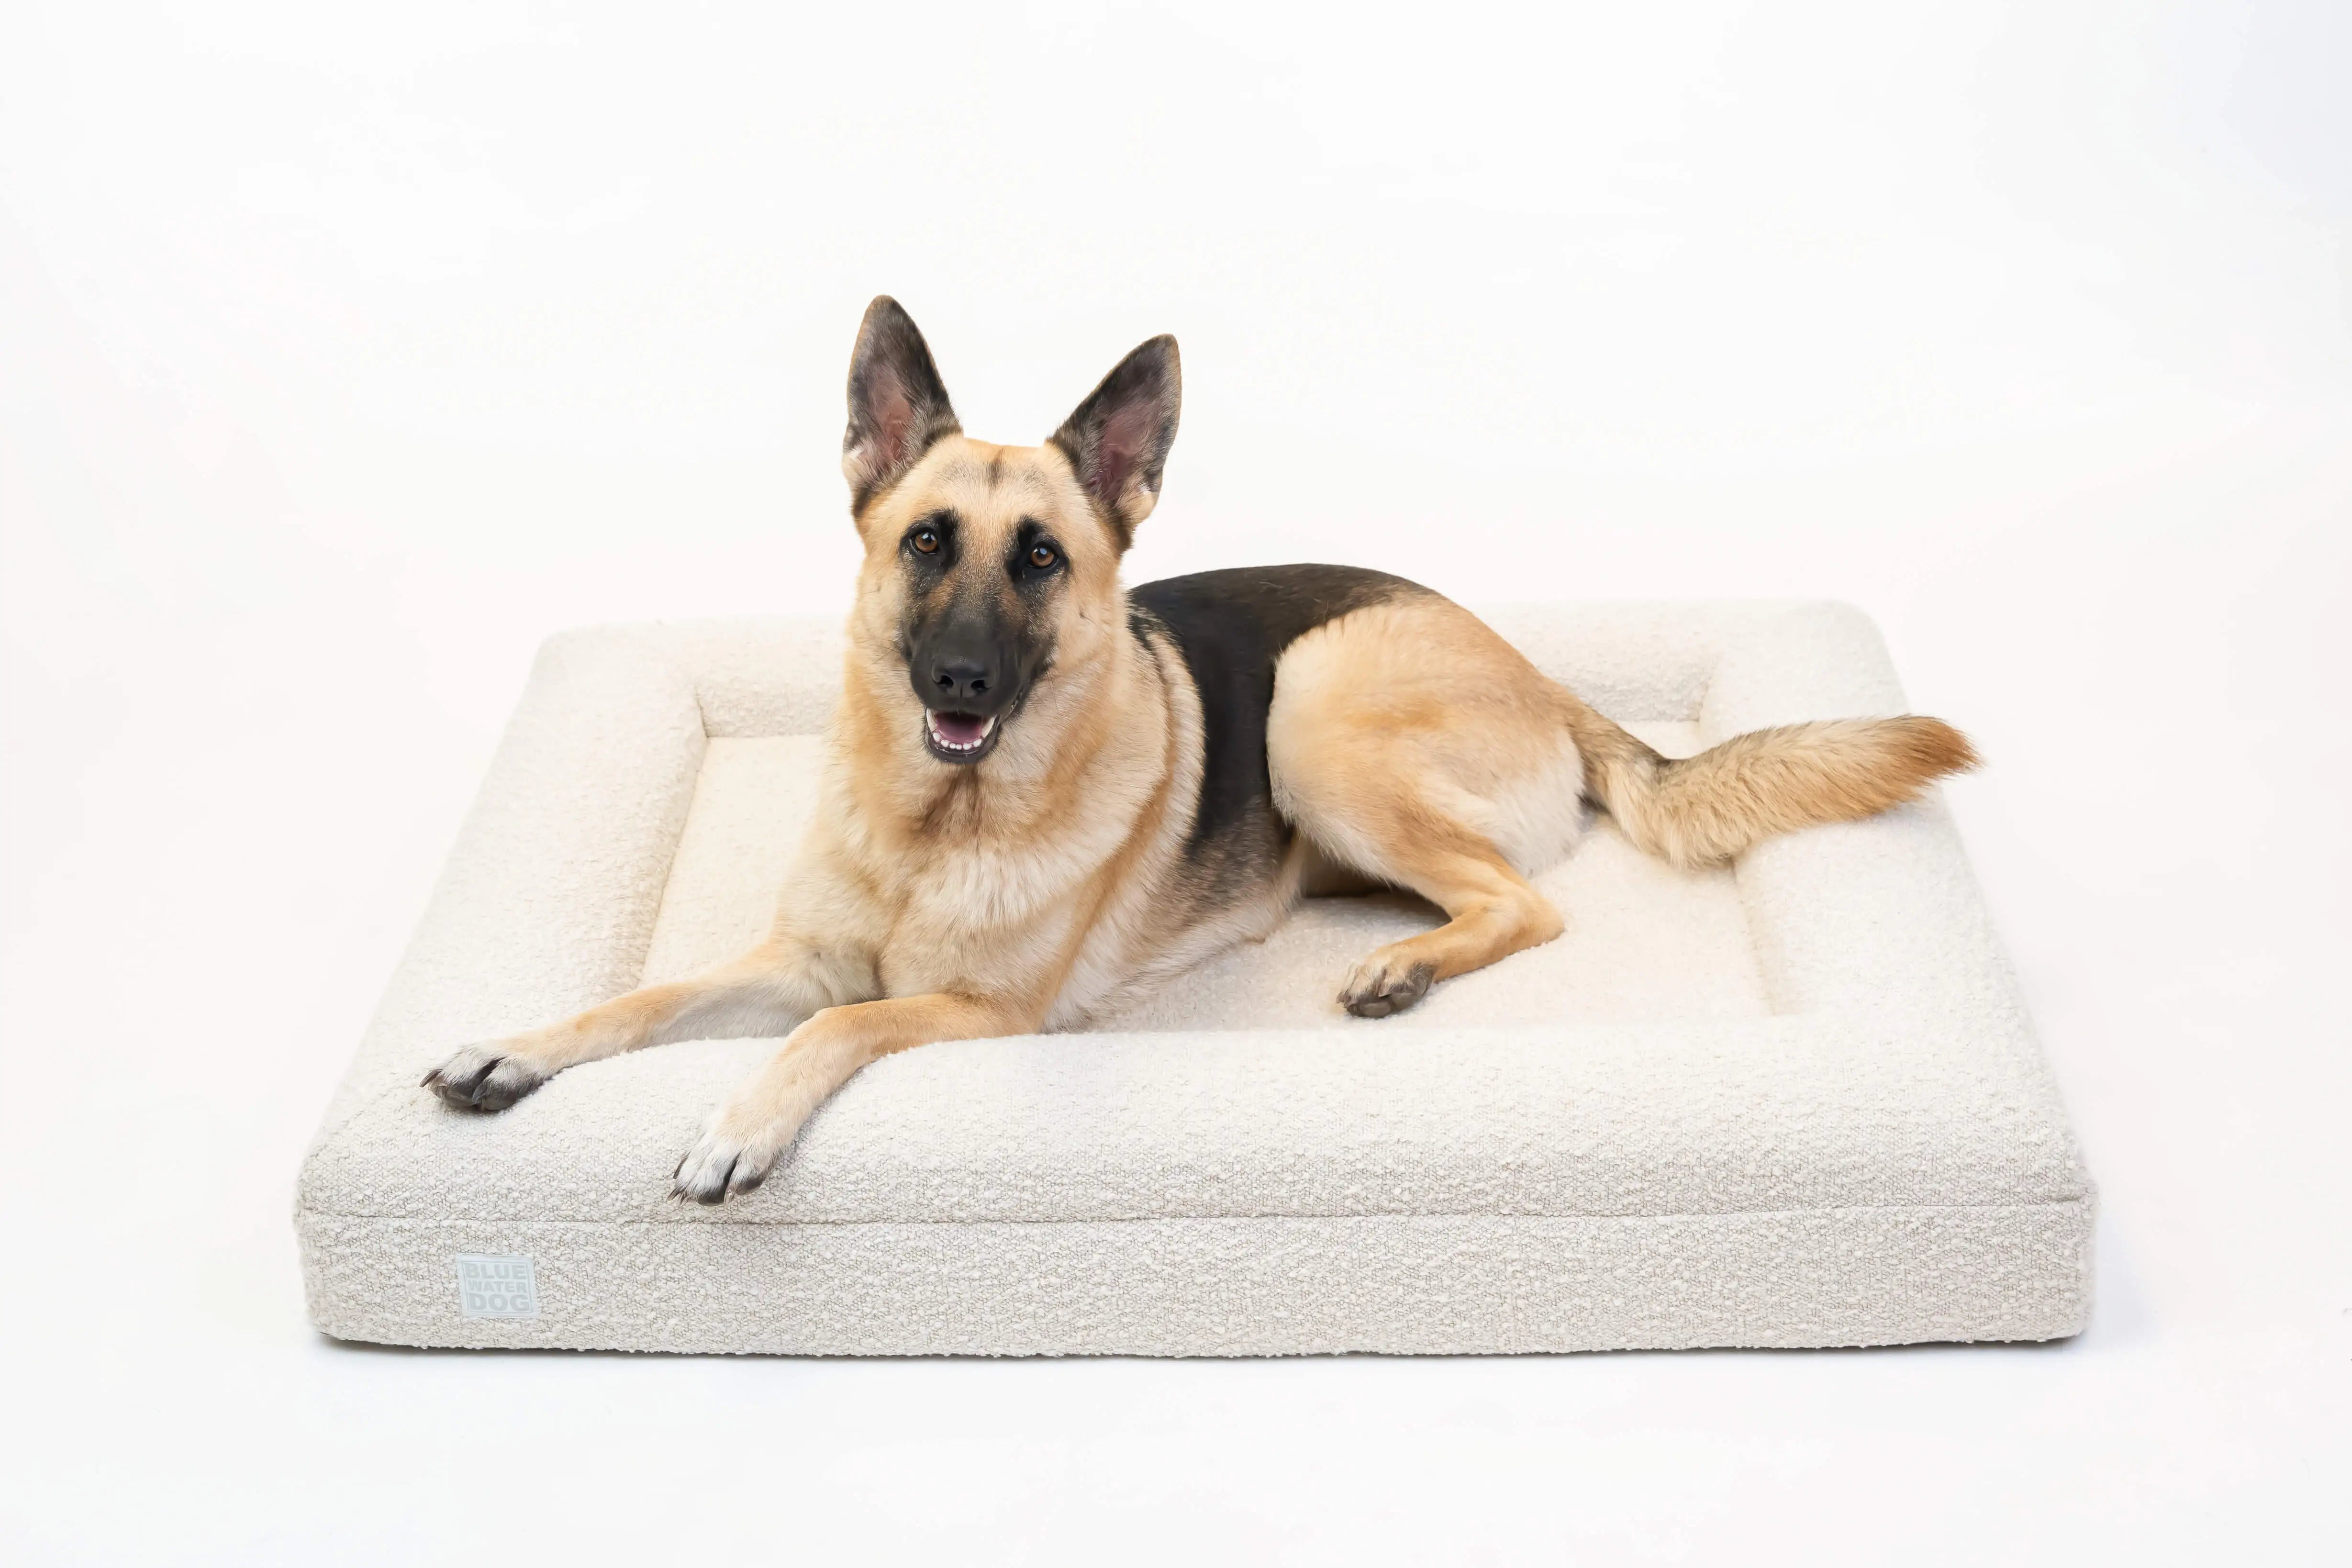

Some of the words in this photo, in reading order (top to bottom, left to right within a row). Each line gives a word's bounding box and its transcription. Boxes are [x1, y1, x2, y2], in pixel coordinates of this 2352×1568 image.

[465, 1263, 526, 1279] BLUE
[468, 1280, 527, 1293] WATER
[469, 1293, 529, 1312] DOG
